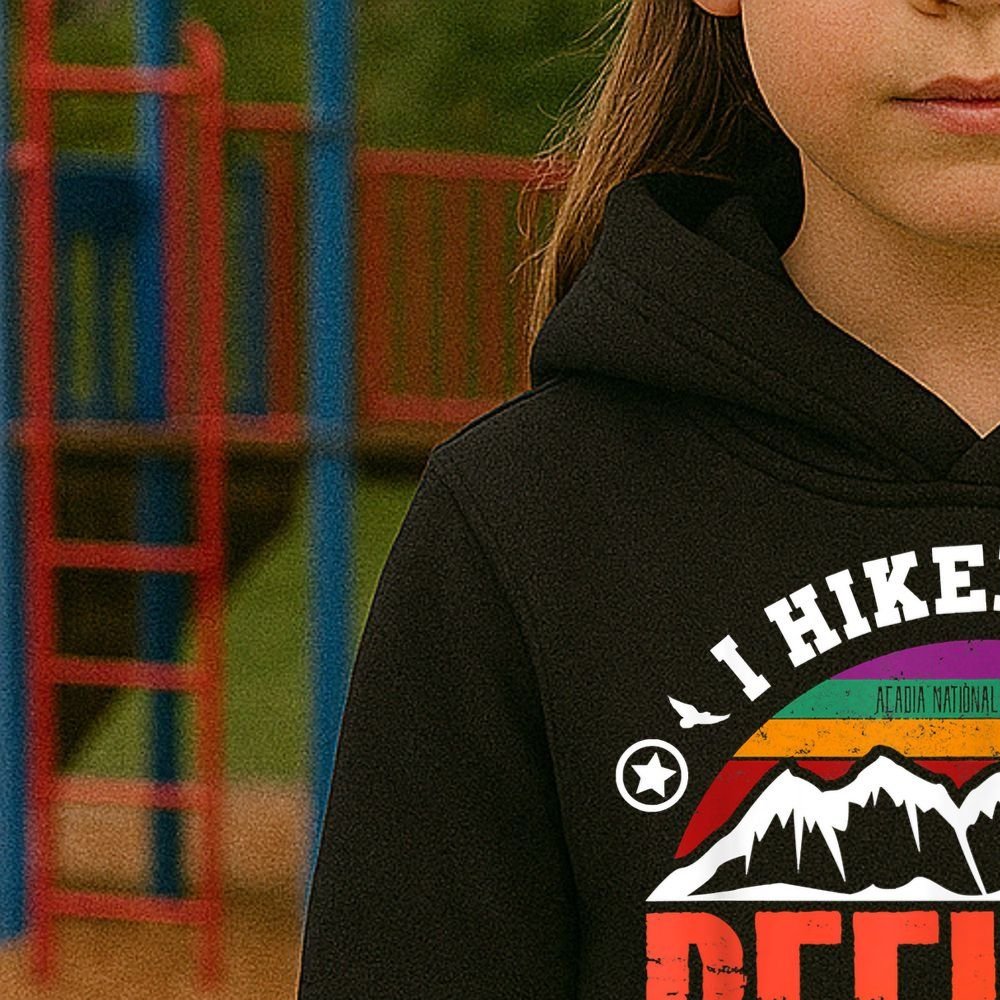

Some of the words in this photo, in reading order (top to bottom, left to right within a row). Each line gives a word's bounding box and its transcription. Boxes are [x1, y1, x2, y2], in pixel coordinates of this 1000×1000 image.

[710, 634, 771, 702] I
[875, 686, 925, 714] ACADIA
[933, 685, 998, 713] NATIONAL
